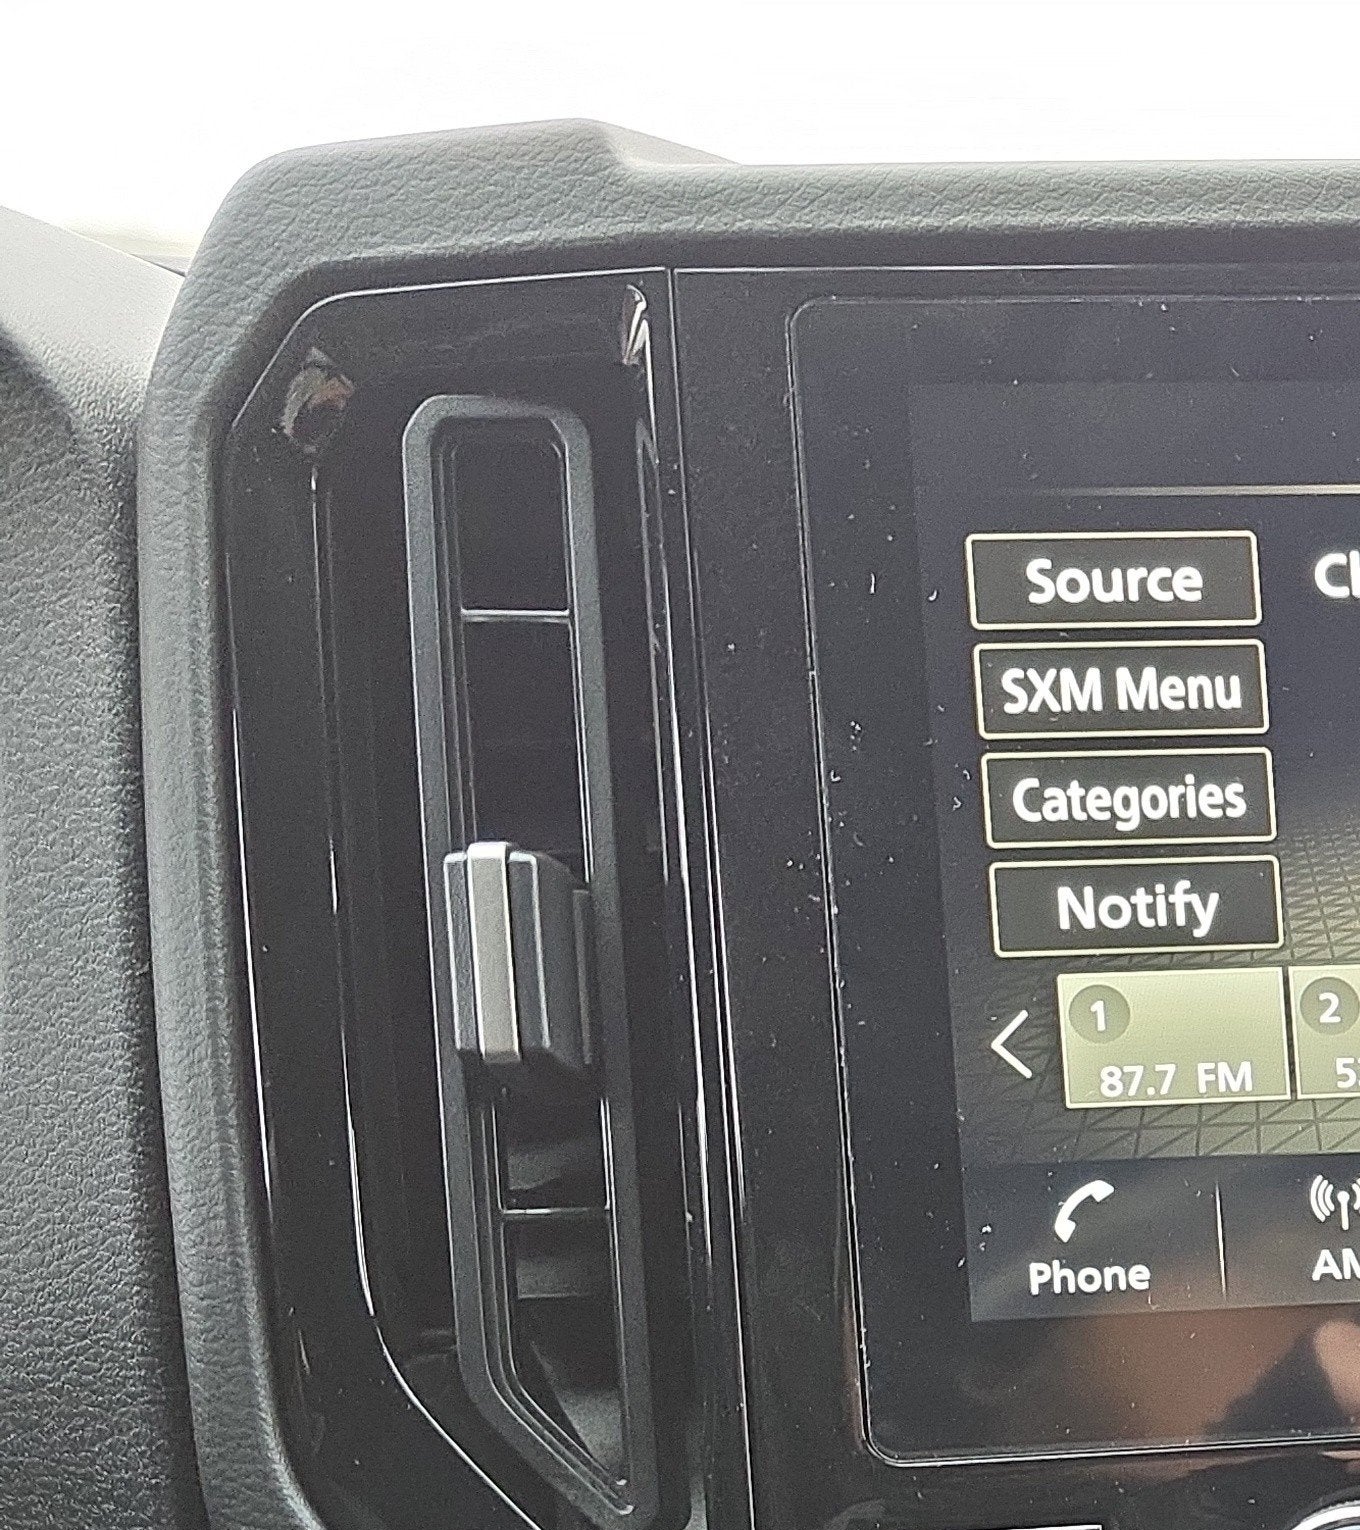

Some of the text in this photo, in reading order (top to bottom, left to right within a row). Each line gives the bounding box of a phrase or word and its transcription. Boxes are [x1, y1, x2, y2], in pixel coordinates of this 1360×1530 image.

[1027, 559, 1202, 604] Source
[1001, 666, 1241, 714] SXM Menu
[1012, 774, 1246, 831] Categories
[1058, 880, 1219, 936] Notify
[1089, 1000, 1106, 1031] 1
[1319, 993, 1342, 1024] 2
[1099, 1061, 1253, 1096] 87.7 FM
[1029, 1259, 1151, 1295] Phone
